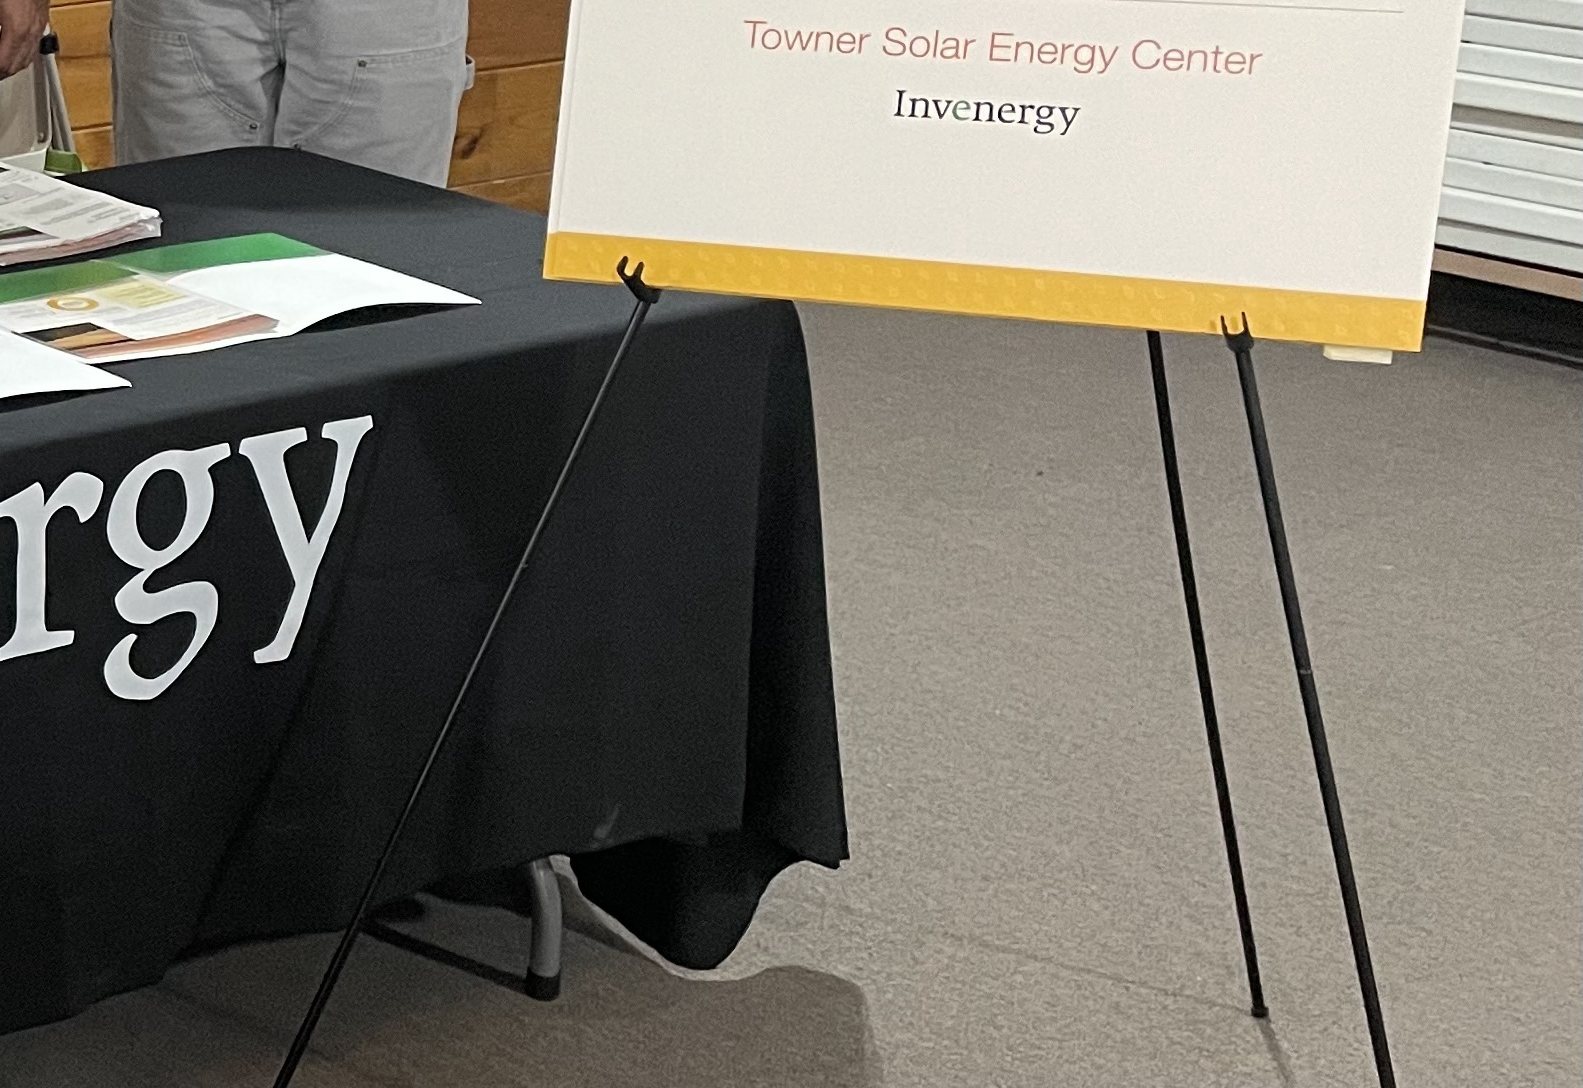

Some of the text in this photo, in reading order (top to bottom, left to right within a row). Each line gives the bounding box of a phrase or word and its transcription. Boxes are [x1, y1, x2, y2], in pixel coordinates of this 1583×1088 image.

[743, 19, 1264, 76] Towner Solar Energy Center
[893, 88, 1082, 137] Invenergy
